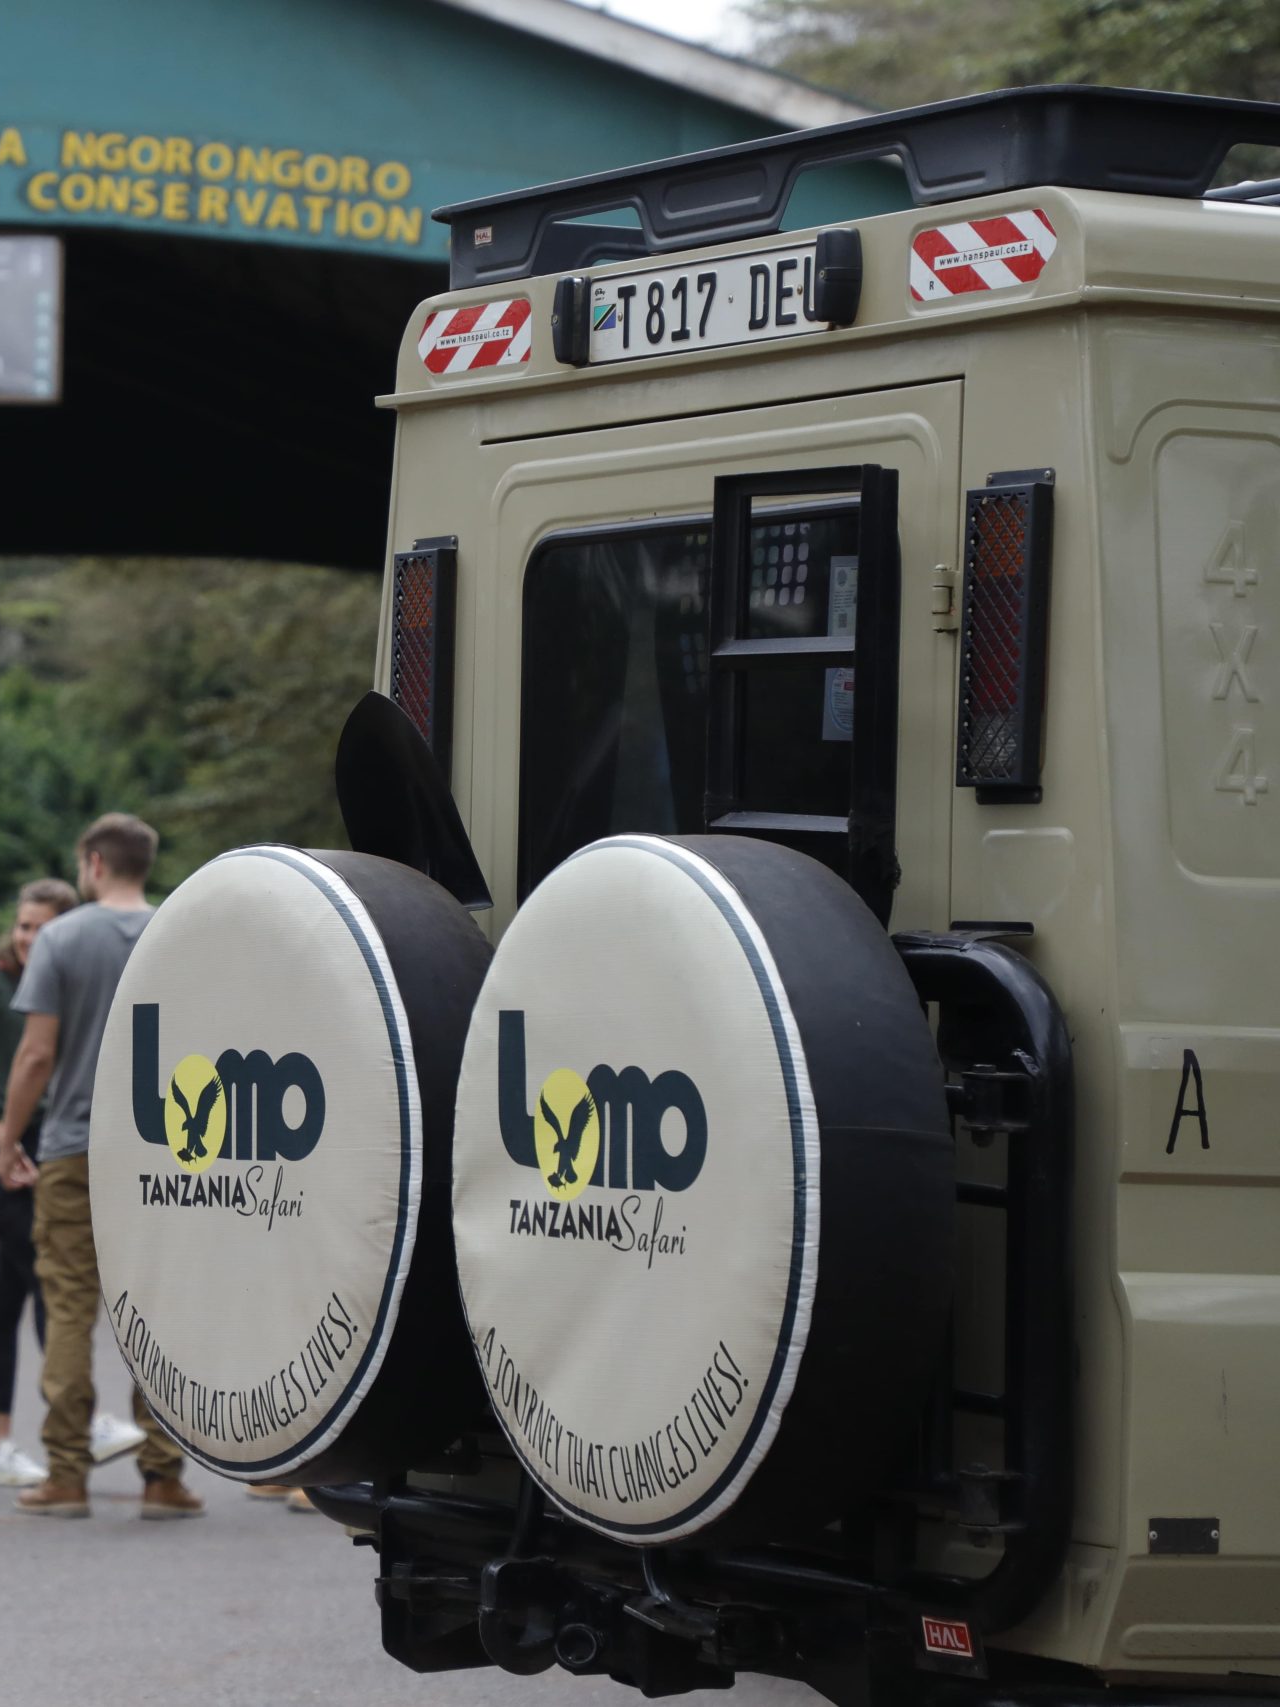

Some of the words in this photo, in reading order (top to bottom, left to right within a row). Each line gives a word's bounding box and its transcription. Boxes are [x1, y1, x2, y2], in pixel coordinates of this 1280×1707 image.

[61, 130, 412, 201] NGORONGORO
[26, 170, 421, 245] CONSERVATION
[929, 280, 935, 291] R
[939, 242, 1029, 267] www.hanspaul.co.tz
[439, 328, 510, 347] www.hanspaul.co.tz
[617, 284, 637, 349] T
[646, 271, 719, 345] 817
[1166, 1049, 1210, 1154] A
[139, 1173, 247, 1209] TANZANIA
[236, 1165, 304, 1232] Safari
[509, 1199, 623, 1243] TANZANIA
[611, 1195, 687, 1270] Safari
[112, 1290, 128, 1329] A
[123, 1305, 187, 1422] JOURNEY
[189, 1381, 227, 1442] THAT
[229, 1361, 308, 1444] CHANGES
[300, 1291, 359, 1399] LIVES!
[483, 1327, 496, 1368] A
[493, 1344, 563, 1476] JOURNEY
[567, 1430, 609, 1500] THAT
[609, 1415, 698, 1504] CHANGES
[684, 1340, 750, 1458] LIVES!
[928, 1624, 966, 1649] HAL
